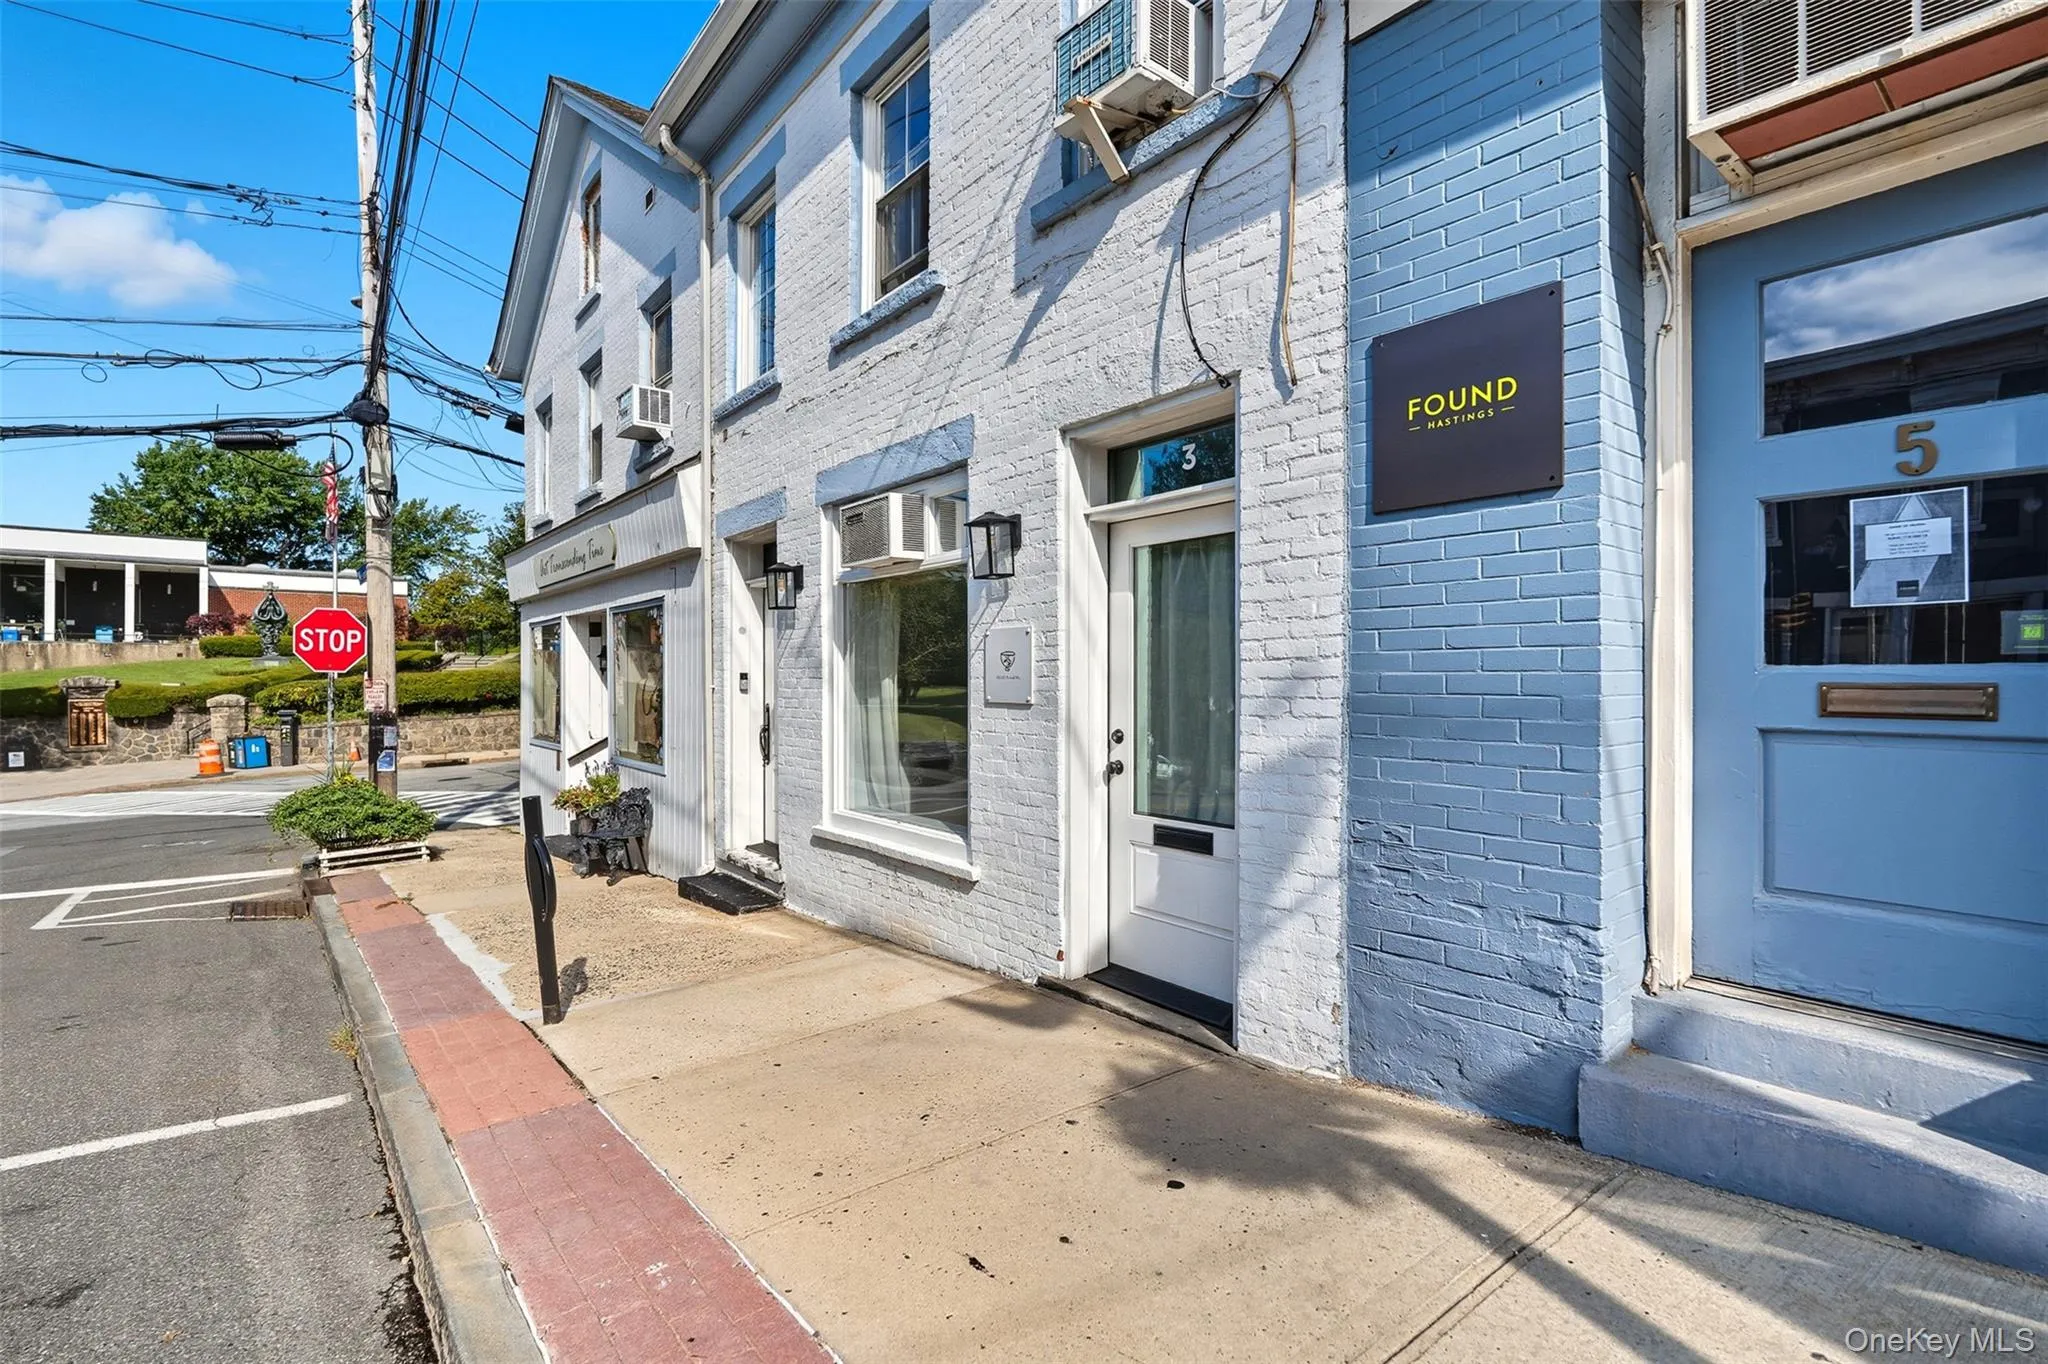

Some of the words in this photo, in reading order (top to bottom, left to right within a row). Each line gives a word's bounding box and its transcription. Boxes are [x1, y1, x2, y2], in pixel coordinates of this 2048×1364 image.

[1408, 376, 1518, 421] FOUND
[1427, 408, 1495, 430] HASTINGS
[1181, 443, 1197, 471] 3
[1895, 420, 1938, 477] 5
[298, 627, 362, 653] STOP
